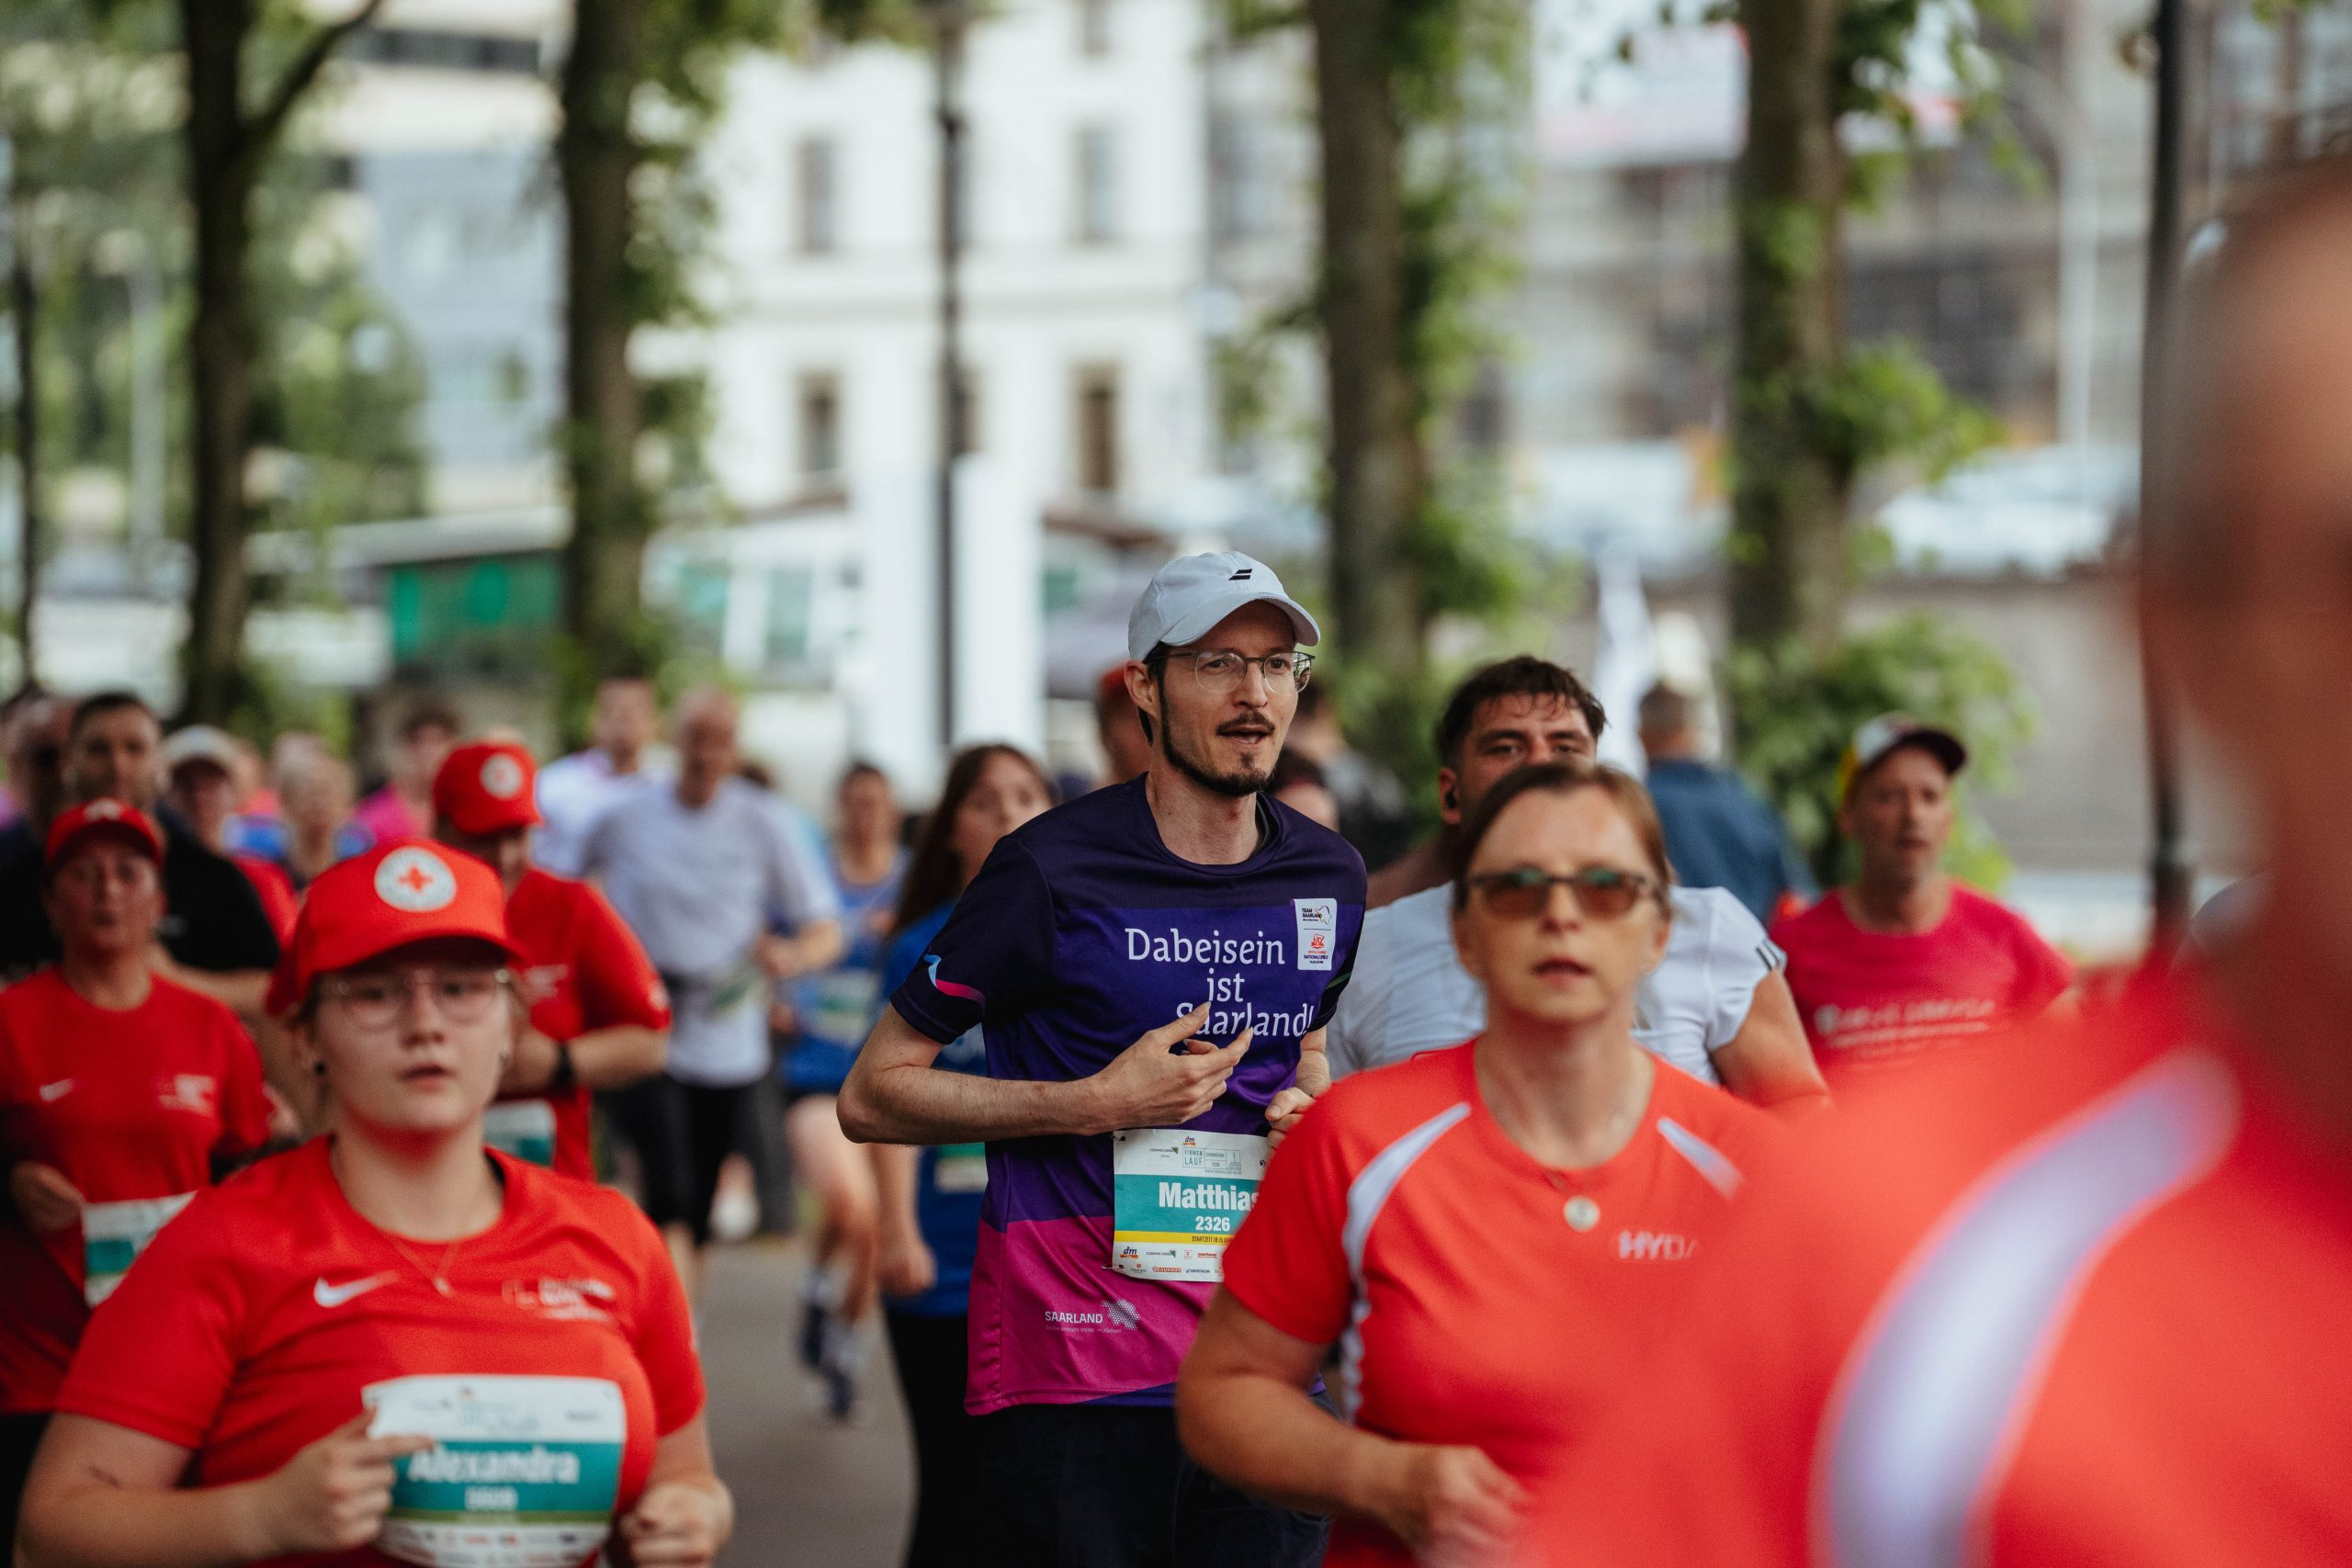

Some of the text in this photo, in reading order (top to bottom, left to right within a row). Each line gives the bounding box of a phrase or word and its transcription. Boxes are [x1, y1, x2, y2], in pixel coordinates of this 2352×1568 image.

[1125, 928, 1284, 964] Dabeisein
[1206, 968, 1245, 1002] ist
[1184, 1157, 1203, 1166] LAUF
[1195, 1216, 1231, 1232] 2326
[1124, 1247, 1137, 1255] dm
[1045, 1311, 1103, 1324] SAARLAND
